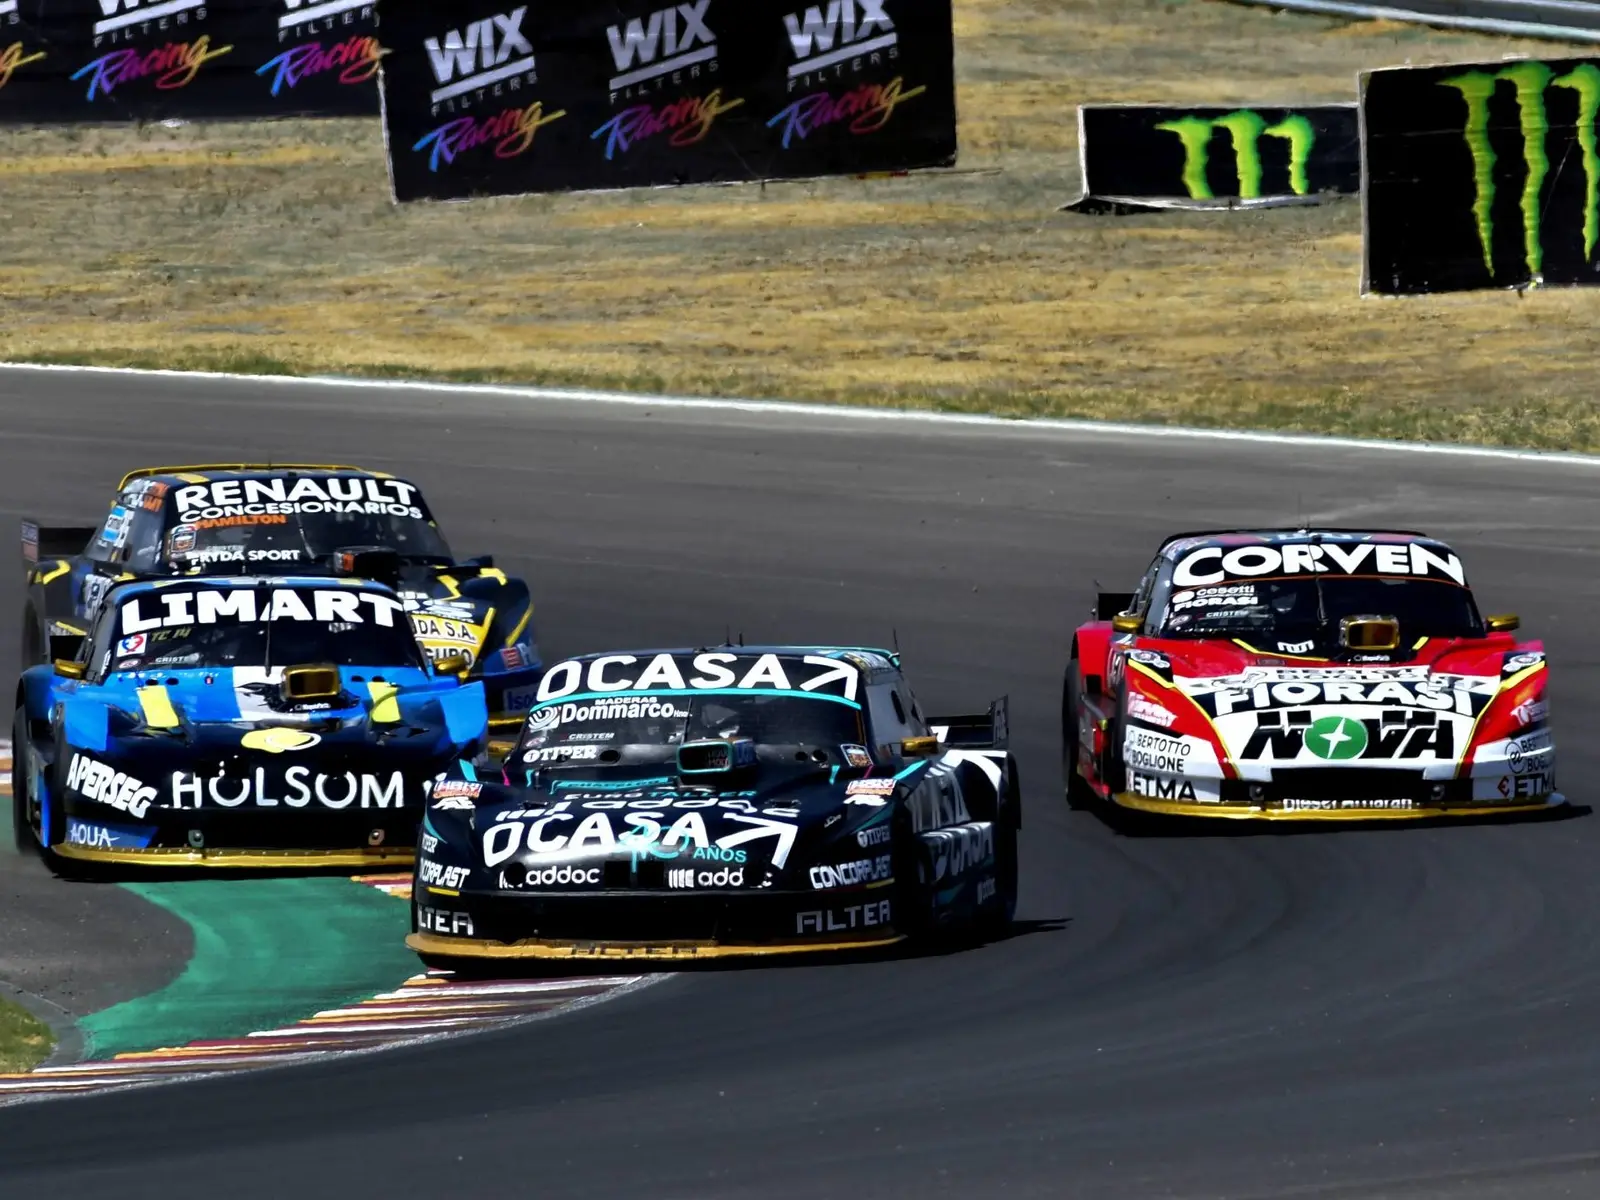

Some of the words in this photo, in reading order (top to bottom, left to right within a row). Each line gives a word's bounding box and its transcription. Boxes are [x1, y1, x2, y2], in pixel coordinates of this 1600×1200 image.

[93, 8, 207, 48] FILTERS
[424, 5, 534, 84] WIX
[607, 0, 717, 72] WIX
[783, 0, 895, 59] WIX
[68, 34, 234, 102] Racing
[610, 60, 719, 106] FILTERS
[787, 48, 899, 93] FILTERS
[431, 71, 538, 118] FILTERS
[766, 76, 927, 149] Racing
[412, 100, 567, 173] Racing
[590, 88, 745, 161] Racing
[175, 478, 416, 513] RENAULT
[180, 501, 423, 523] CONCESIONARIOS
[195, 515, 287, 530] HAMILTON
[248, 550, 300, 561] SPORT
[1172, 542, 1465, 587] CORVEN
[122, 589, 403, 635] LIMART
[561, 703, 674, 723] Dommarco
[595, 696, 657, 705] MADERAS
[1216, 681, 1474, 716] FIORASI
[569, 732, 614, 740] CRISTEM
[1137, 733, 1191, 756] BERTOTTO
[1132, 749, 1185, 773] BOGLIONE
[66, 753, 158, 819] APERSEG
[1133, 771, 1198, 801] ETMA
[693, 847, 747, 863] AÑOS
[526, 866, 600, 885] addoc
